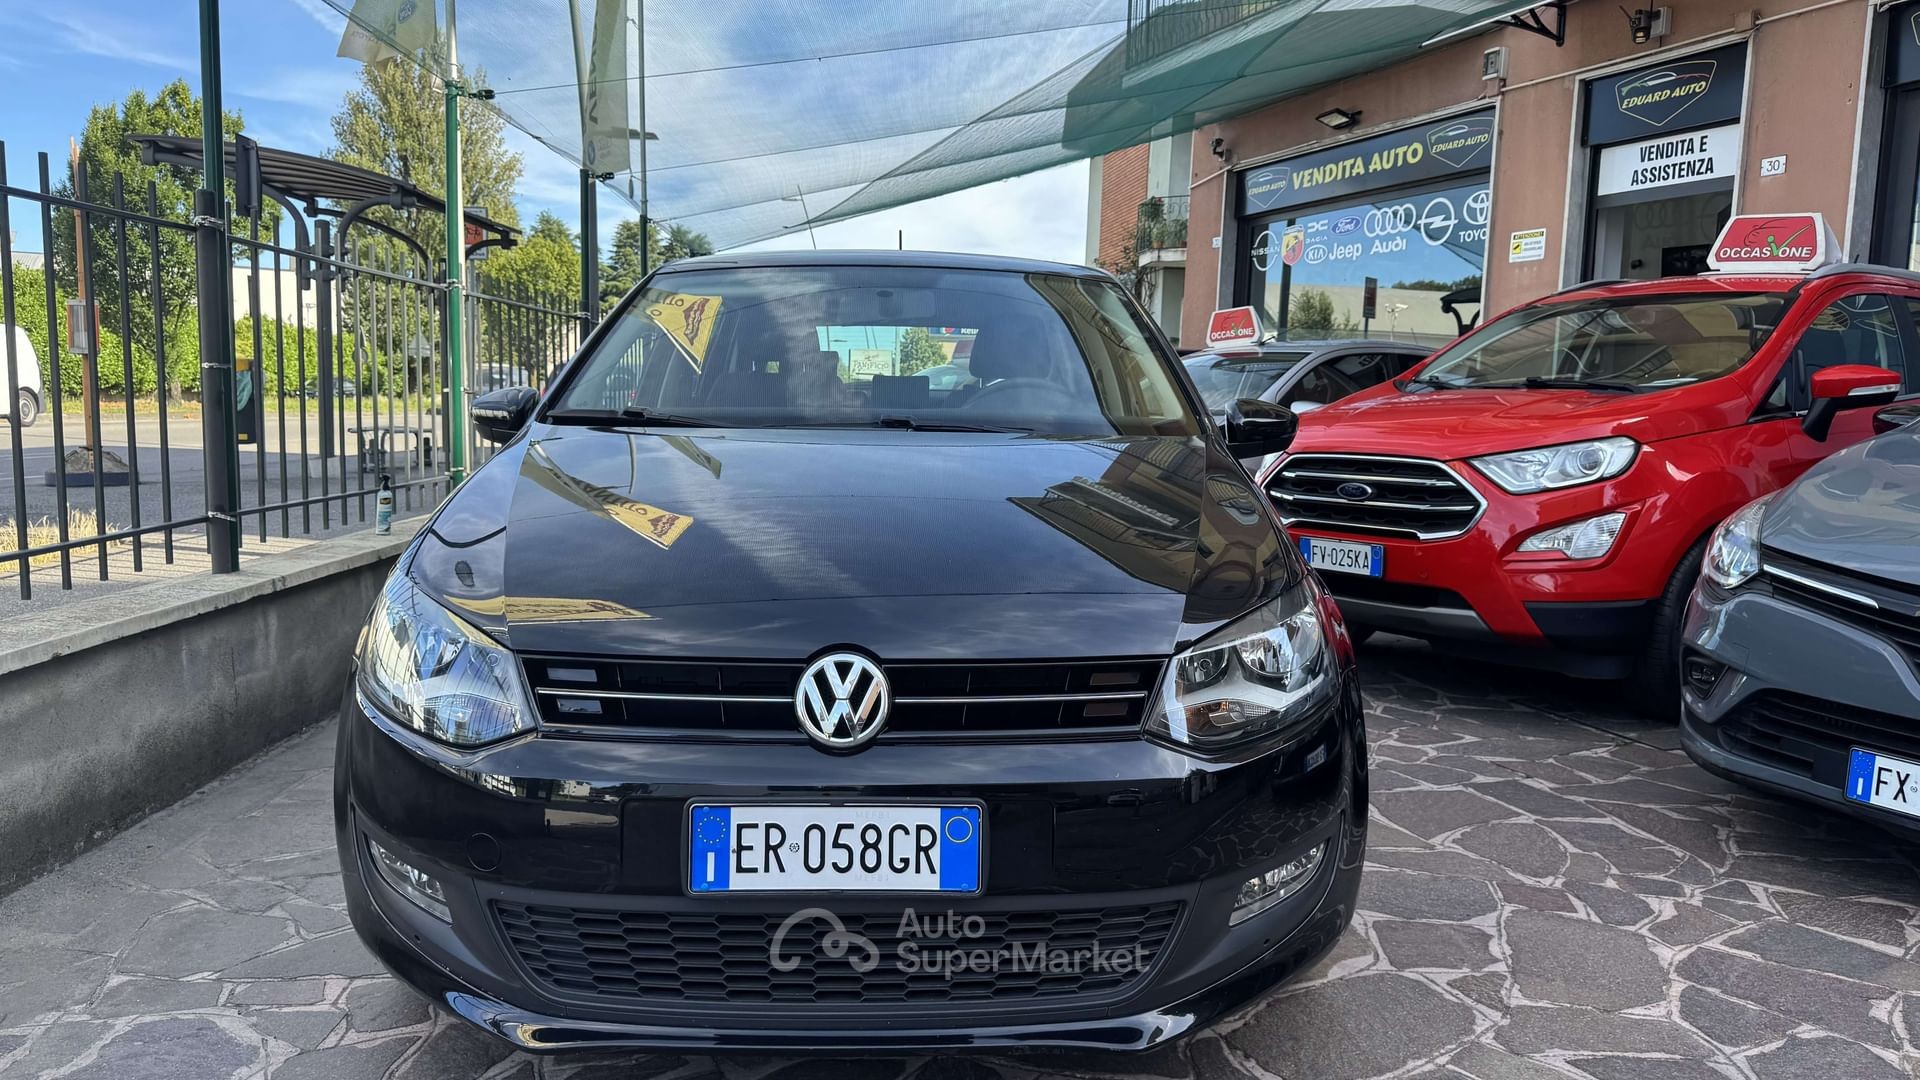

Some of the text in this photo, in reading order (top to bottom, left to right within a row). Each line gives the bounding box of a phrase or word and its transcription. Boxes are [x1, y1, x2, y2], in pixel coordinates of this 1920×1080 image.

[1622, 81, 1706, 109] EDUARD AUTO
[1432, 133, 1488, 153] EDUARD AUTO
[1640, 135, 1709, 163] VENDITA E
[1292, 142, 1424, 191] VENDITA AUTO
[1631, 157, 1714, 186] ASSISTENZA
[1766, 160, 1780, 172] 30
[1251, 245, 1280, 257] NISSAN
[1307, 249, 1325, 261] KIA
[1328, 242, 1362, 261] Jeep
[1370, 236, 1407, 255] Audi
[1875, 766, 1910, 803] FX
